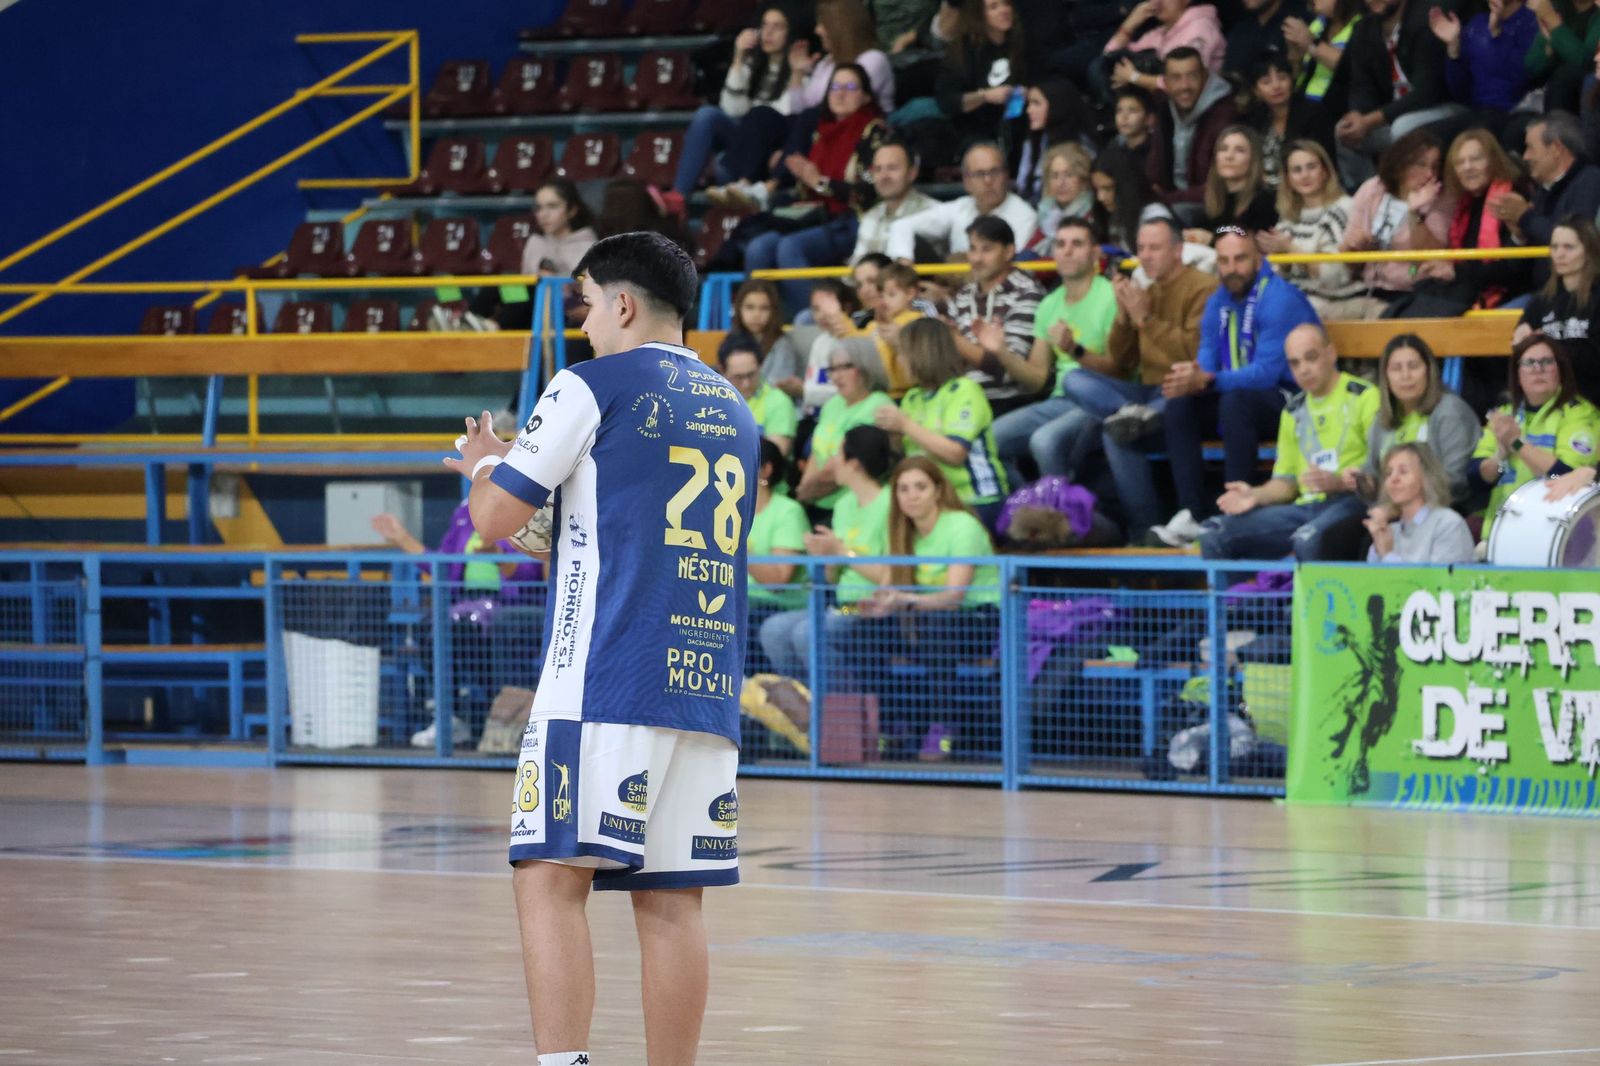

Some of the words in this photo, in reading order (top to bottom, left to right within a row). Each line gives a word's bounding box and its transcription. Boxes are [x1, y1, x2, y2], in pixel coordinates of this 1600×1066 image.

[685, 421, 737, 437] sangregorio
[664, 445, 746, 557] 28
[678, 552, 734, 588] NÉSTOR
[679, 628, 730, 643] INGREDIENTS
[667, 647, 714, 674] PRO
[1412, 685, 1508, 760] DE
[1473, 774, 1600, 812] BALONM
